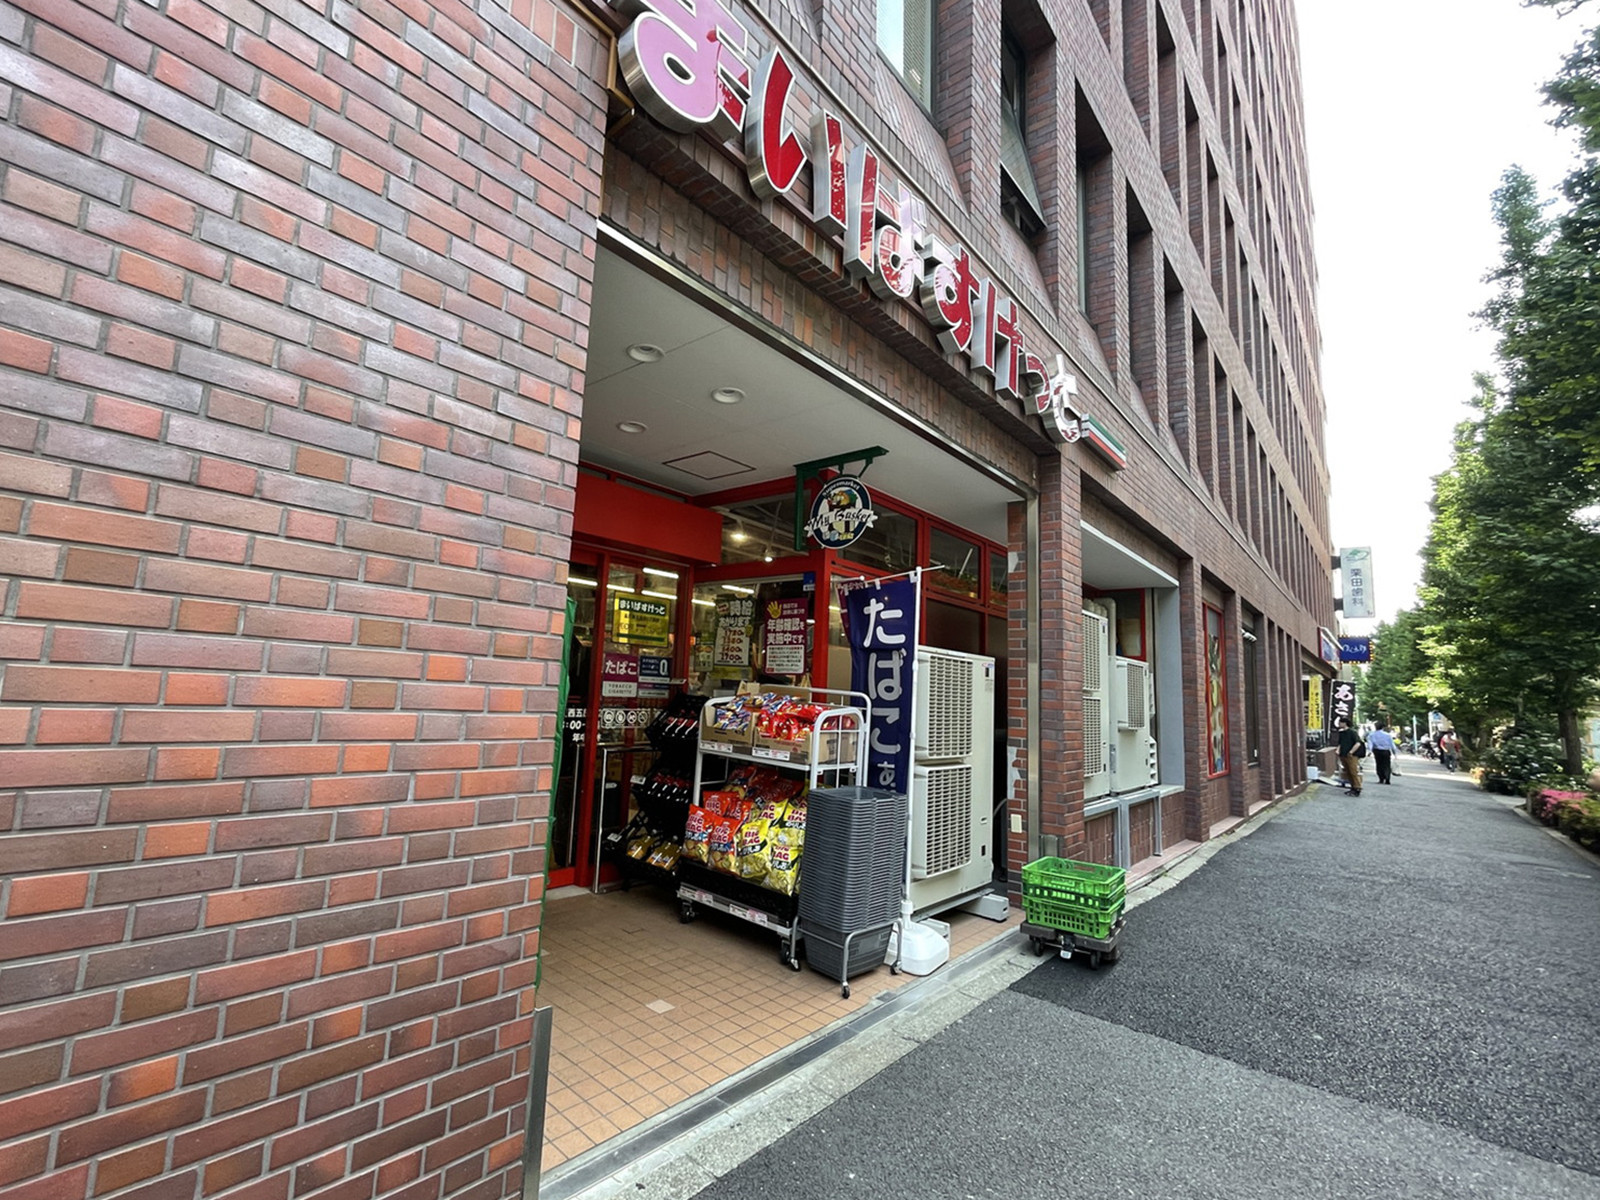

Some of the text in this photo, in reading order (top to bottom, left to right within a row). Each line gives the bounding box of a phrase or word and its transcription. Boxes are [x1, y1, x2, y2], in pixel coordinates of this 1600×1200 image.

[634, 0, 1080, 443] まいばすけっと
[808, 508, 871, 530] My Basket
[619, 599, 666, 615] まいばすけっと
[767, 618, 805, 631] 年齢確認を
[605, 660, 637, 675] たばこ
[862, 598, 908, 755] たばこ
